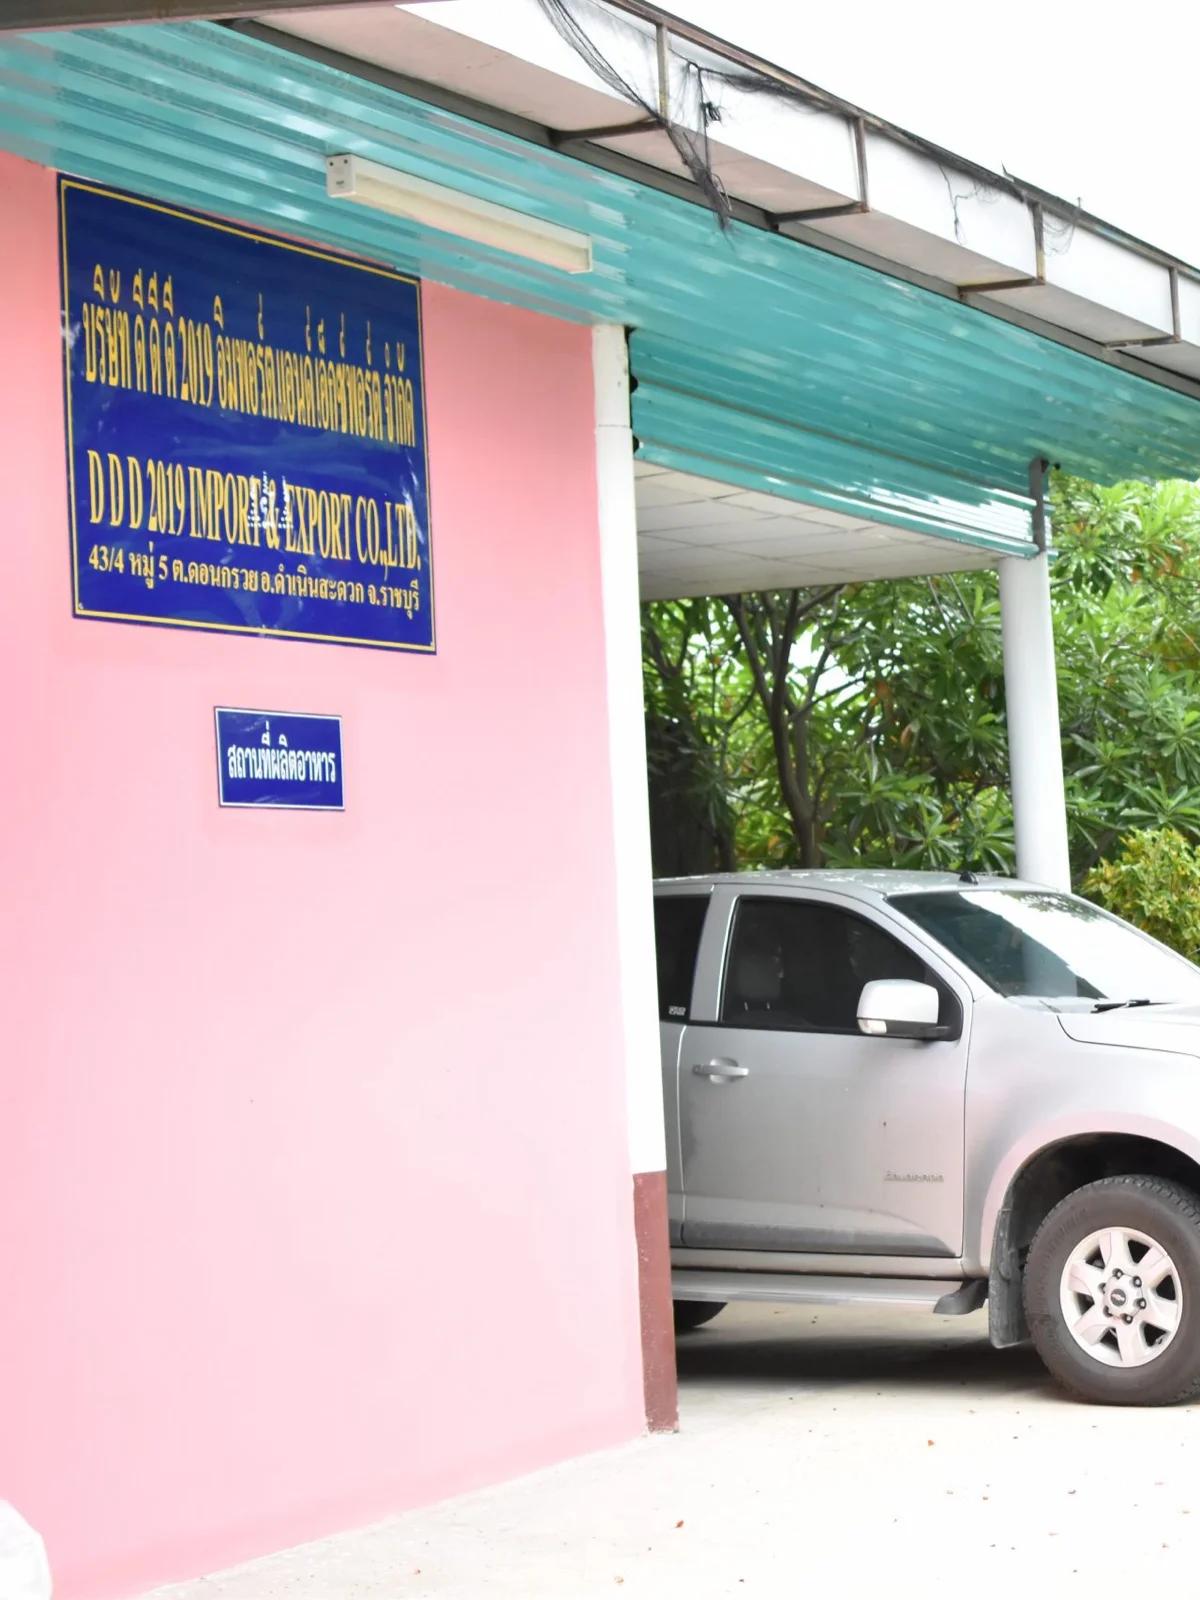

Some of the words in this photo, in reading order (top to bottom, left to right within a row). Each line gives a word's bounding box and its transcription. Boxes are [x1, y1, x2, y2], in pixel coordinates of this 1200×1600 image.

[83, 263, 132, 390] บริษัท
[133, 267, 148, 393] ดี
[148, 271, 162, 396] ดี
[163, 274, 178, 399] ดี
[178, 315, 214, 407] 2019
[384, 341, 416, 447] จำกัด
[87, 449, 105, 524] D
[107, 452, 124, 527] D
[127, 455, 144, 530] D
[147, 458, 186, 536] 2019
[188, 466, 261, 547] IMPORT
[264, 479, 280, 551] &
[284, 483, 352, 561] EXPORT
[88, 544, 125, 574] 43/4
[128, 540, 155, 590] หมู่
[158, 554, 169, 580] 5
[367, 578, 421, 620] จ.ราชบุรี
[227, 719, 336, 783] สถานที่ผลิตอาหาร
